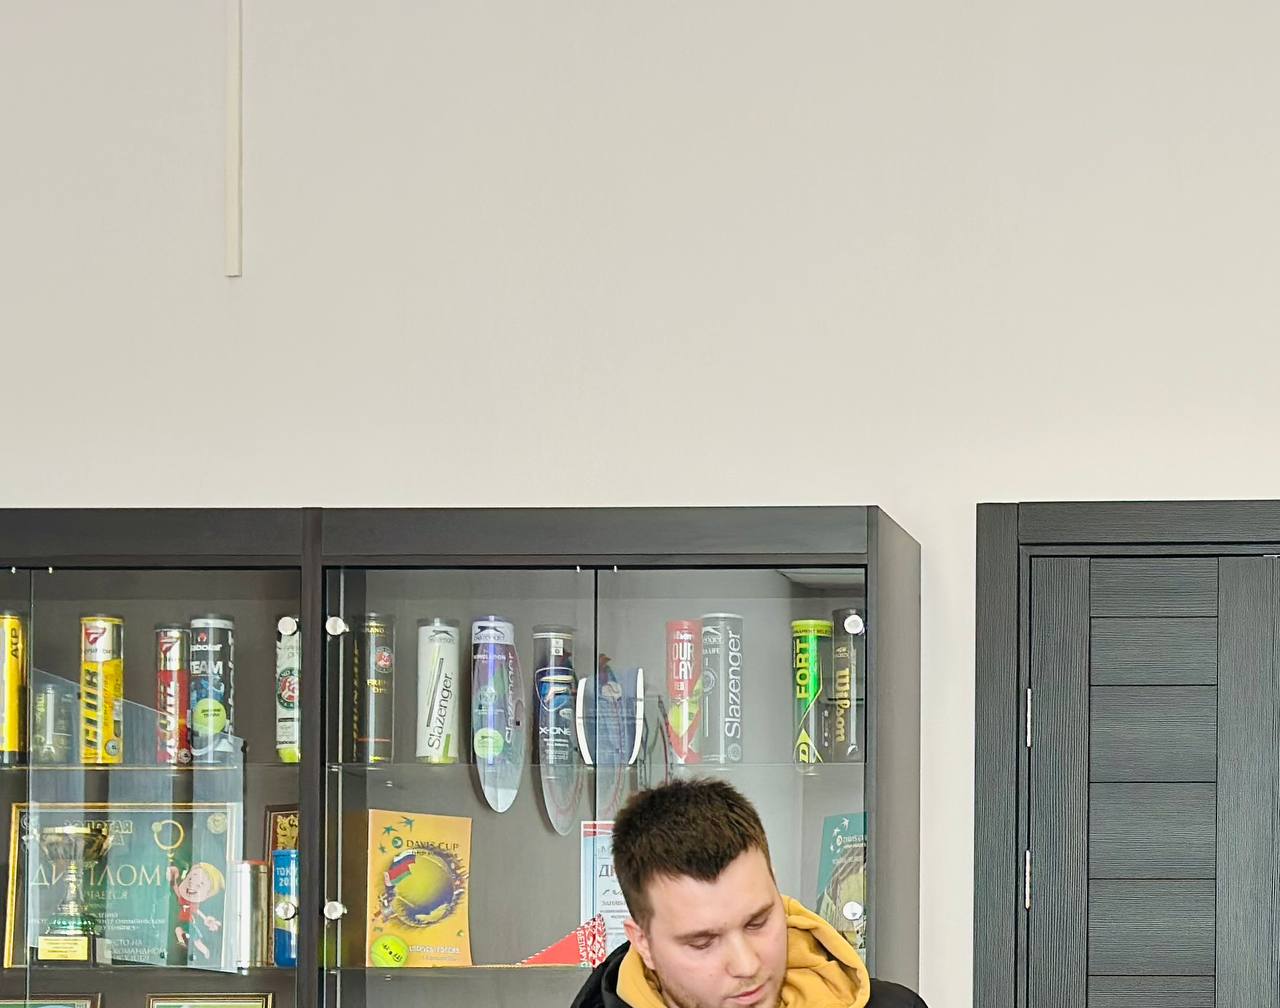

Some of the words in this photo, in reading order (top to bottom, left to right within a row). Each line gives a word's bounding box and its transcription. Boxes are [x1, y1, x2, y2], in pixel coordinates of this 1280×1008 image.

[10, 627, 19, 659] ATP
[190, 643, 223, 652] abolat
[672, 642, 695, 661] OUR
[672, 660, 695, 680] LAY
[726, 629, 742, 739] Slazenger
[796, 639, 810, 699] FORT
[427, 672, 454, 750] Slazenger
[835, 667, 851, 742] Wilson
[276, 867, 298, 877] TOK
